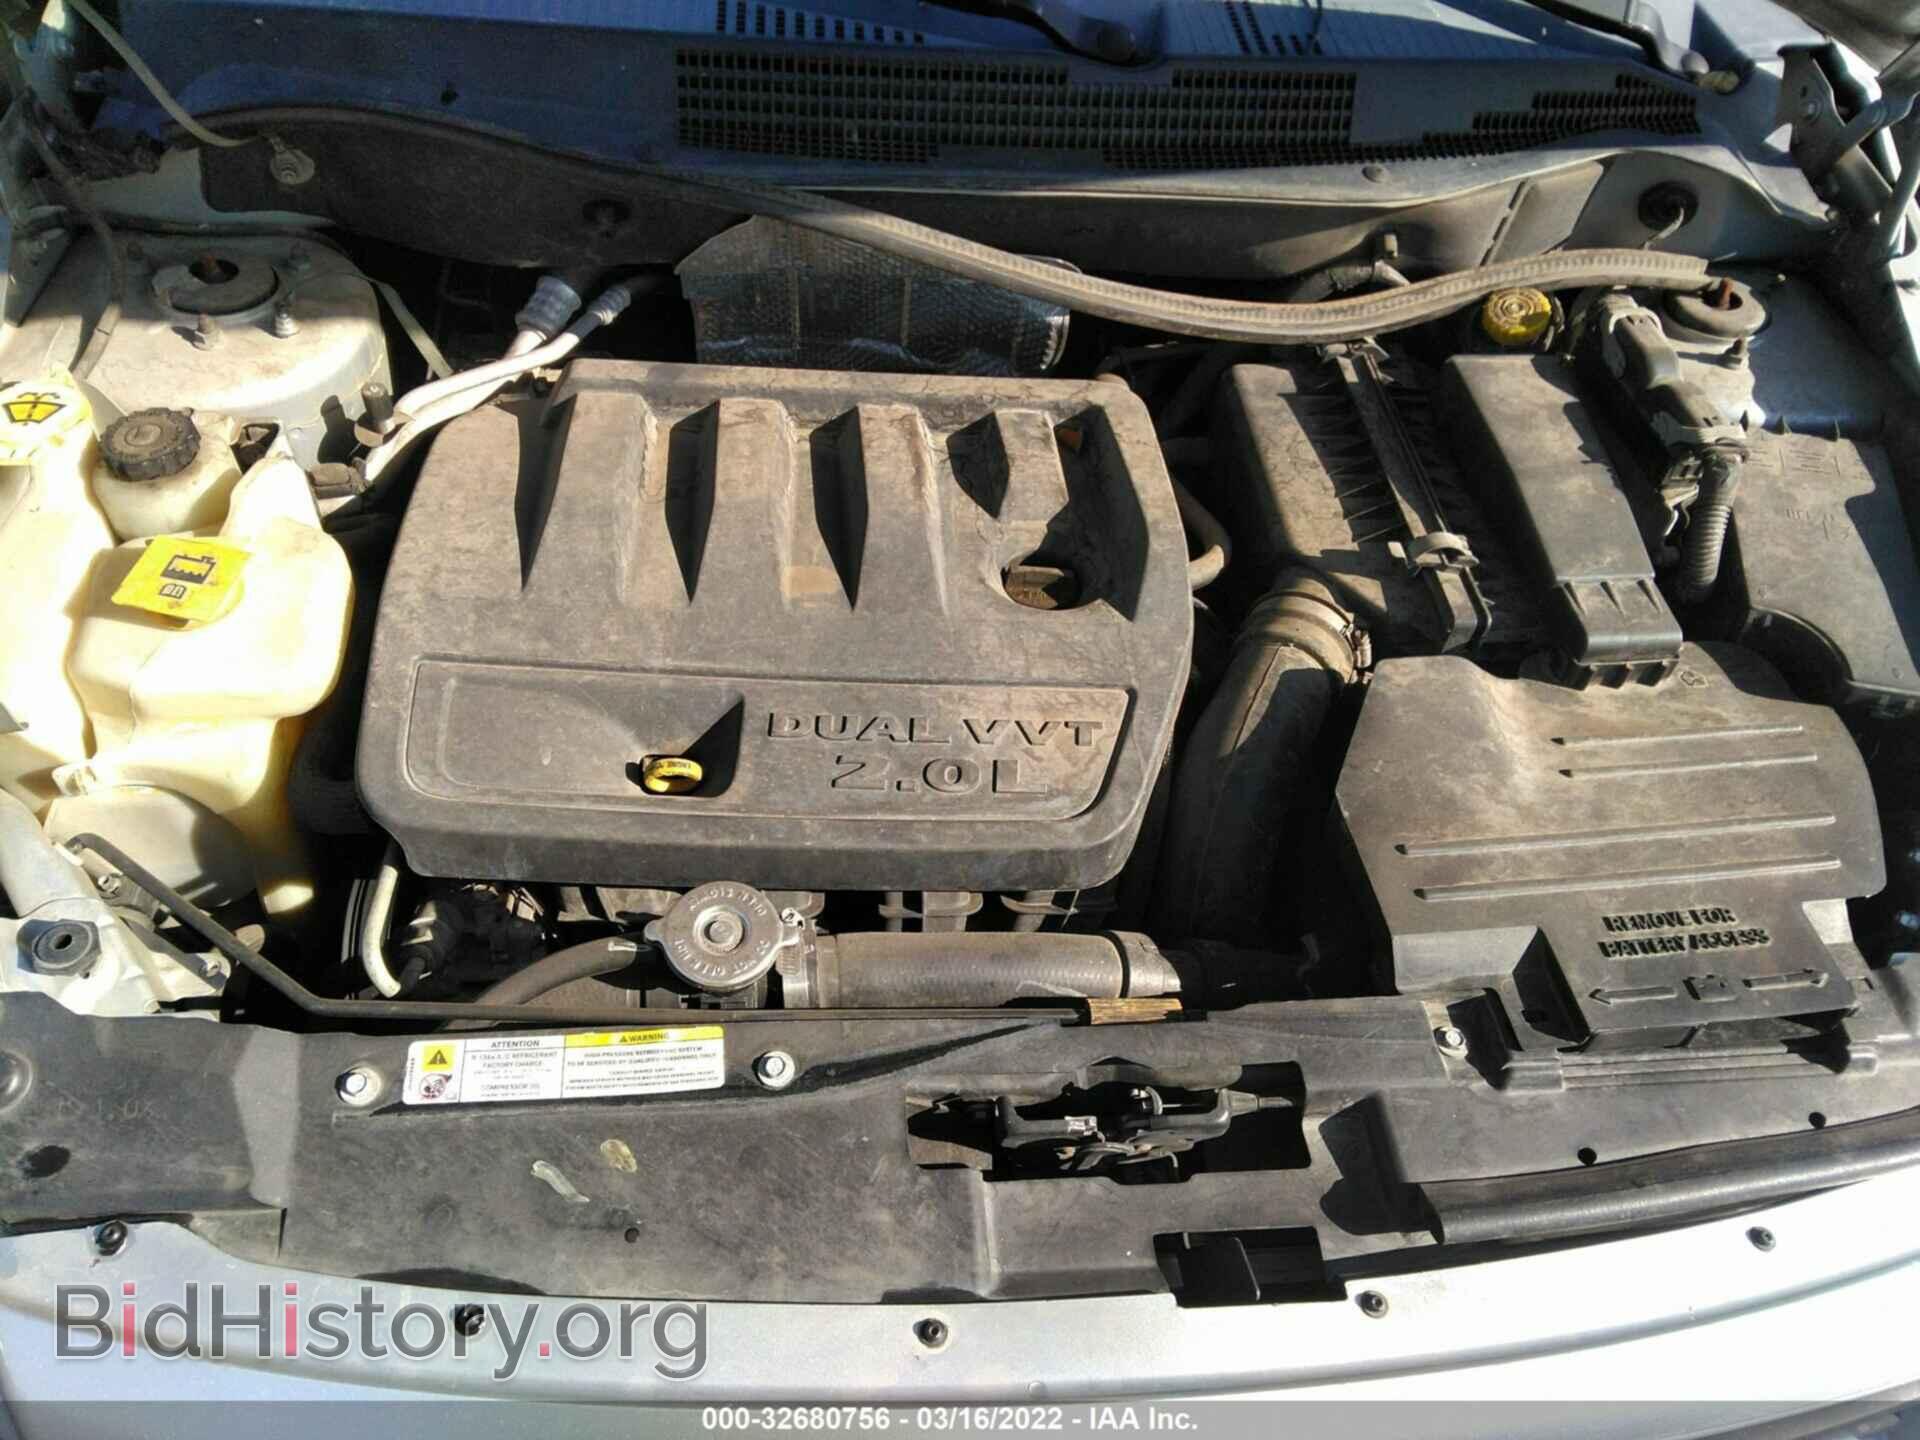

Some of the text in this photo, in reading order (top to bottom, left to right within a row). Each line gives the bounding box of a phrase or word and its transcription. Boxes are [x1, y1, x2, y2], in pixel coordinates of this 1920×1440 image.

[767, 711, 1103, 747] DUAL VVT
[831, 755, 1048, 795] 2.0L
[1602, 907, 1736, 932] REMOVE FOR
[1598, 928, 1770, 958] BATTERY ACCESS
[491, 1040, 540, 1048] ATTENTION
[629, 1032, 670, 1042] WARNING
